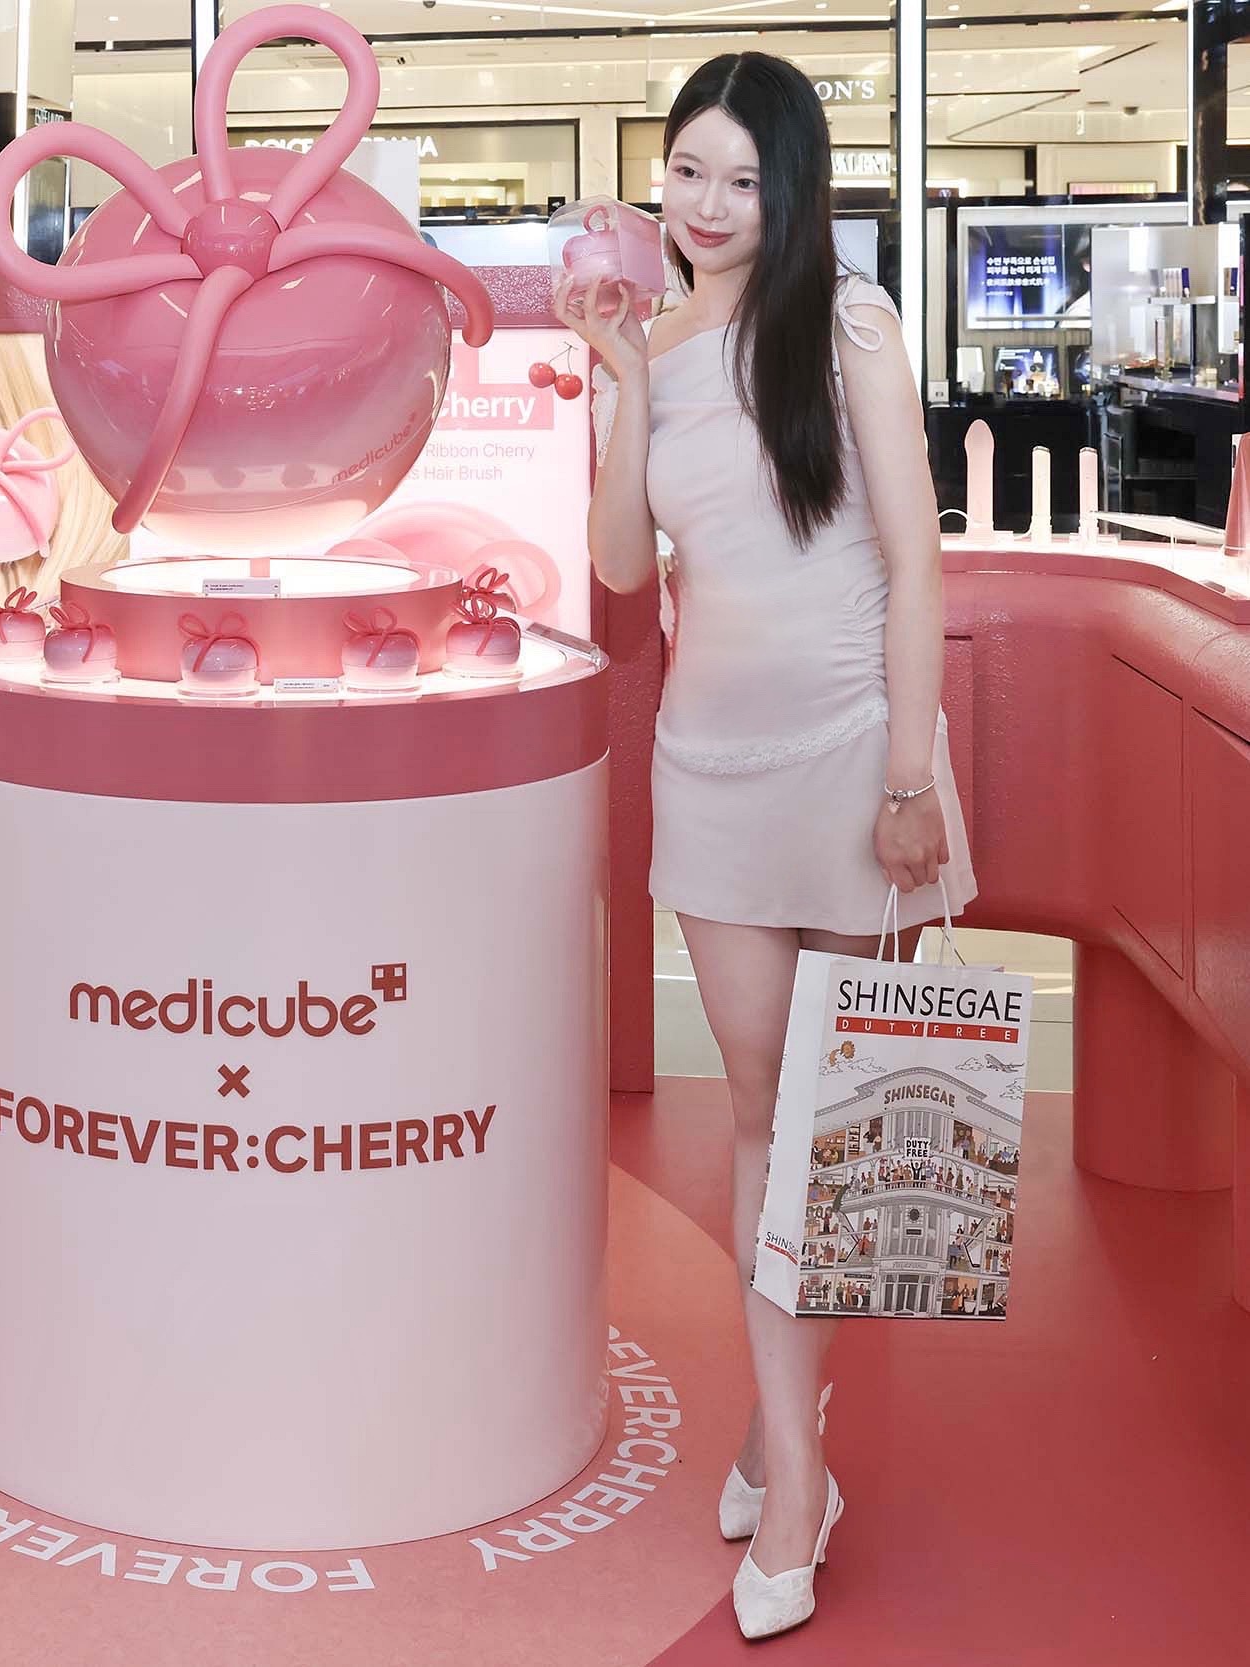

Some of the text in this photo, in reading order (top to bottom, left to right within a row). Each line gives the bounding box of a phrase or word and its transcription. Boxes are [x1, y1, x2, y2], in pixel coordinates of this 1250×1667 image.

[332, 427, 412, 484] medicube
[426, 444, 535, 462] Ribbon Cherry
[424, 466, 454, 480] Hair
[459, 466, 503, 480] Brush
[69, 977, 378, 1038] medicube
[837, 979, 1023, 1022] SHINSEGAE
[841, 1018, 1012, 1041] DUTY FREE
[883, 1084, 956, 1108] SHINSEGAE
[906, 1140, 929, 1149] DUTY
[906, 1148, 928, 1158] FREE
